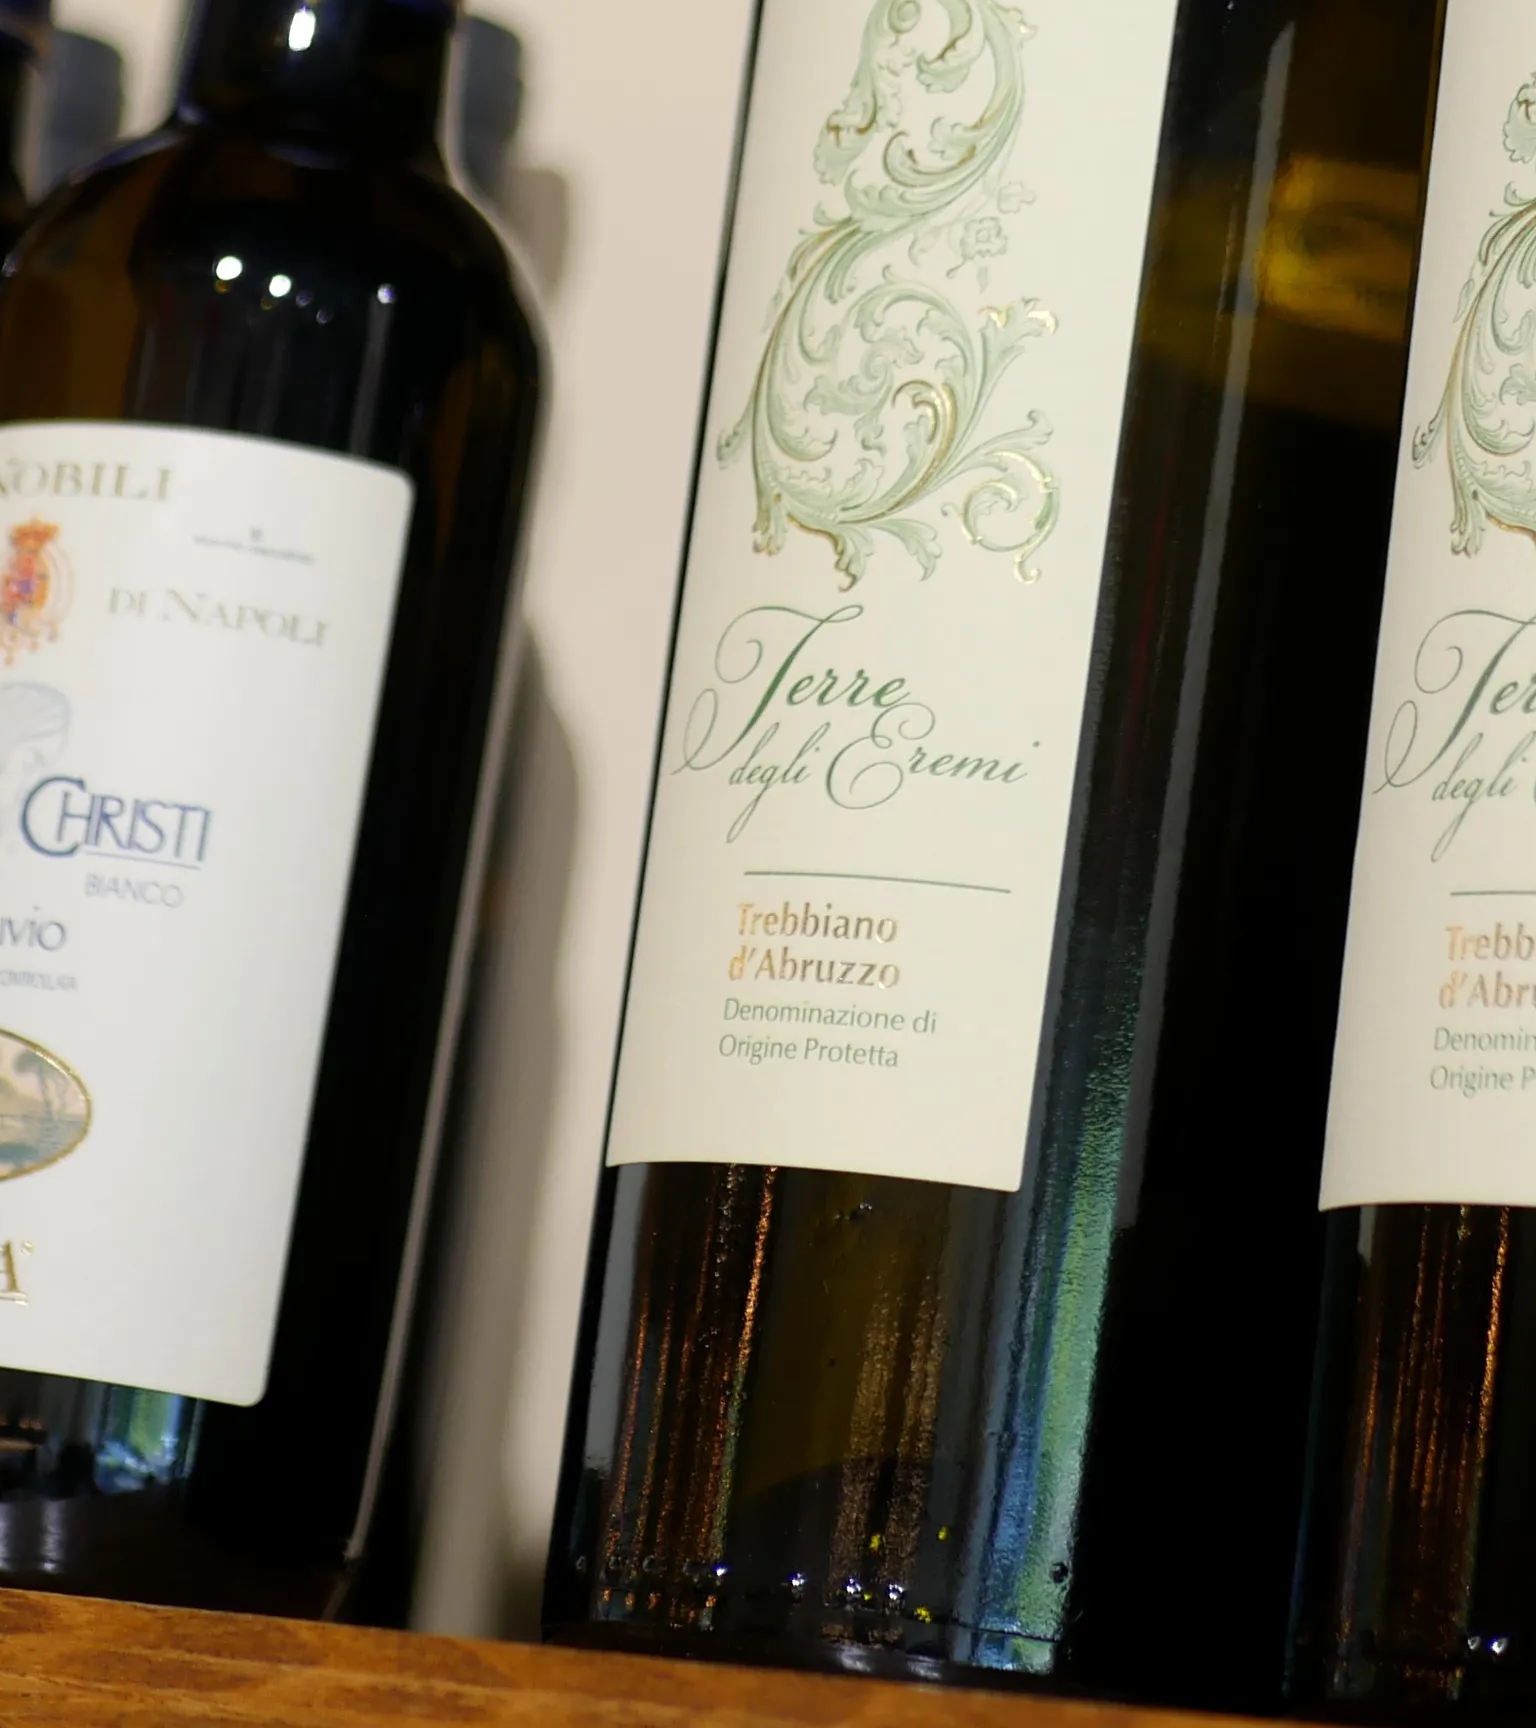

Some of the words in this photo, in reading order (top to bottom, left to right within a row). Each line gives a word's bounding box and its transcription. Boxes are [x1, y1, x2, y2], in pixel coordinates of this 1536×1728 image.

[670, 603, 910, 776] Terre
[726, 721, 831, 844] degli
[824, 701, 1042, 811] Eremi
[737, 900, 898, 944] Trebbiano
[722, 996, 906, 1033] Denominazione
[911, 1009, 938, 1035] di
[718, 1033, 798, 1067] Origine
[803, 1036, 900, 1069] Protetta
[1429, 1063, 1515, 1100] Origine
